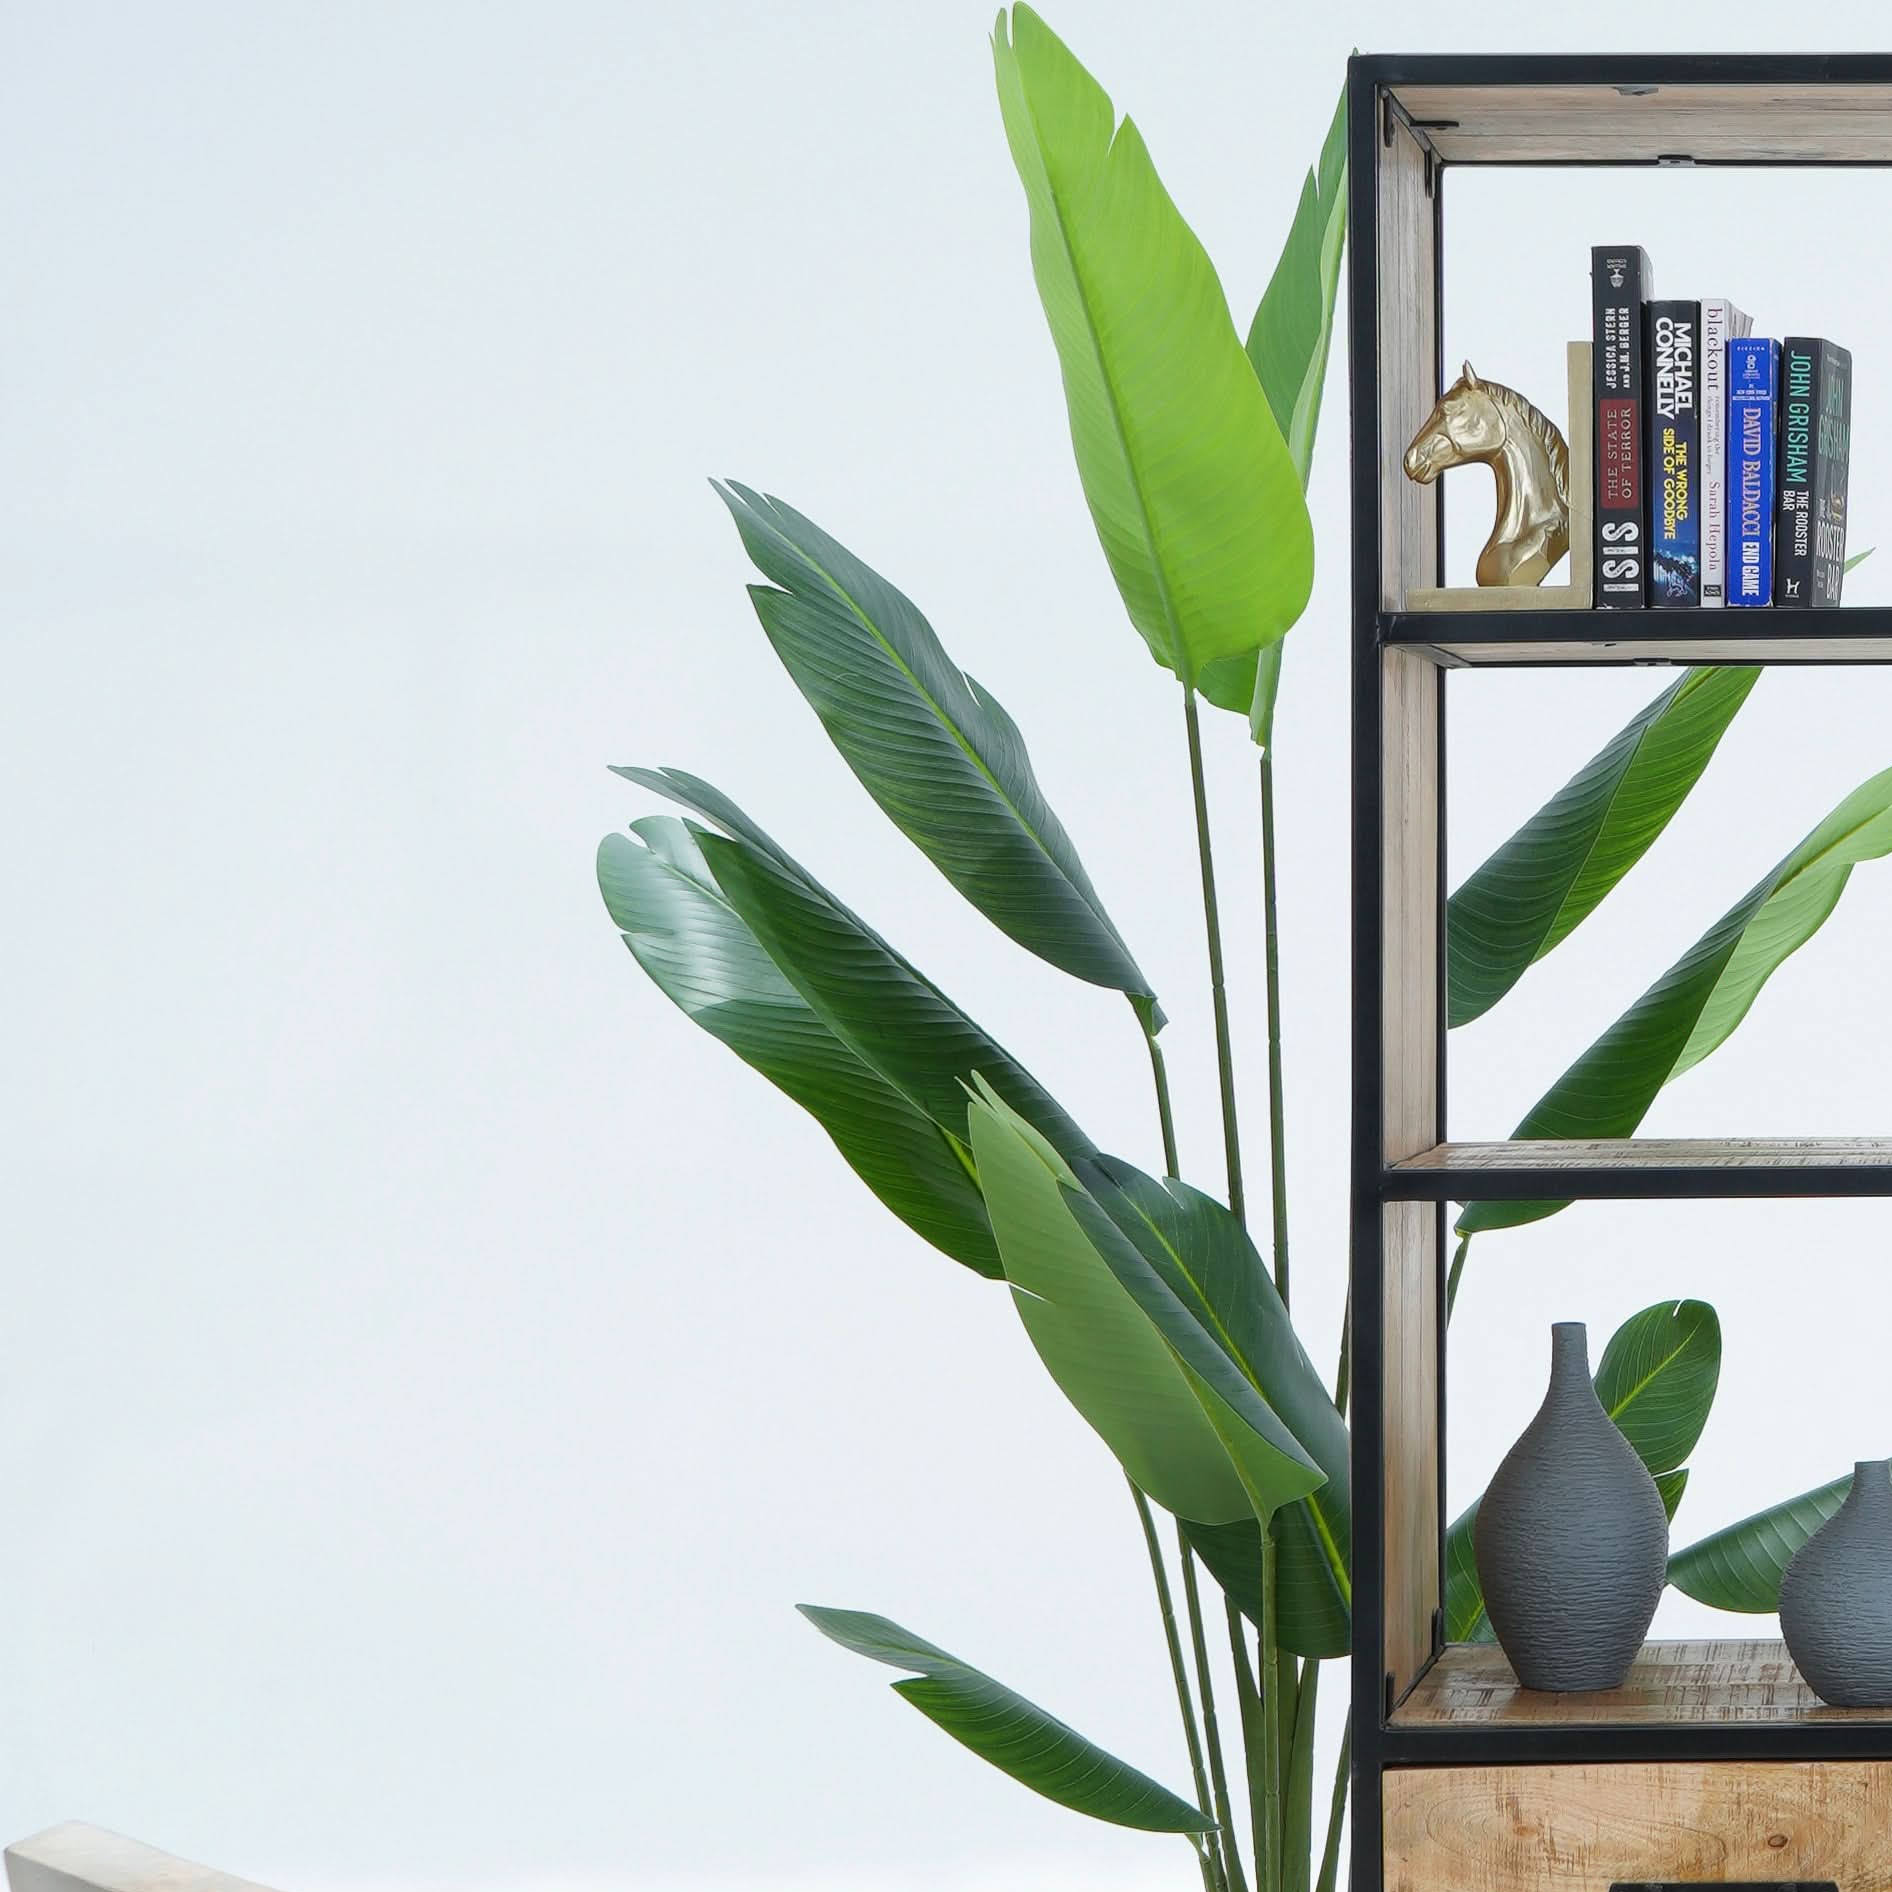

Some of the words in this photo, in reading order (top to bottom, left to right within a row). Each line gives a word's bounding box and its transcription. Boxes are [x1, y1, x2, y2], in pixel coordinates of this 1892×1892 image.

[1605, 307, 1616, 341] STERN
[1619, 307, 1630, 349] BERGER
[1605, 345, 1617, 389] JESSICA
[1655, 316, 1675, 421] CONNELLY
[1673, 322, 1693, 415] MICHAEL
[1707, 308, 1723, 391] blackout
[1789, 350, 1812, 398] JOHN
[1607, 408, 1618, 460] STATE
[1621, 407, 1632, 473] TERROR
[1663, 427, 1675, 455] SIDE
[1675, 441, 1688, 466] THE
[1743, 407, 1761, 456] DAVID
[1786, 403, 1810, 484] GRISHAM
[1608, 467, 1618, 500] THE
[1663, 456, 1675, 475] OF
[1621, 480, 1632, 499] OF
[1663, 478, 1676, 540] GOODBYE
[1676, 468, 1688, 521] WRONG
[1708, 481, 1721, 519] Sarah
[1742, 460, 1761, 537] BALDACCI
[1782, 489, 1796, 511] BAR
[1796, 490, 1809, 510] THE
[1706, 523, 1721, 571] Hepola
[1742, 541, 1760, 564] END
[1794, 511, 1809, 557] ROOSTER
[1816, 520, 1845, 563] ROOSTER
[1601, 521, 1640, 592] ISIS
[1741, 565, 1760, 597] GAME
[1826, 563, 1840, 602] BAR
